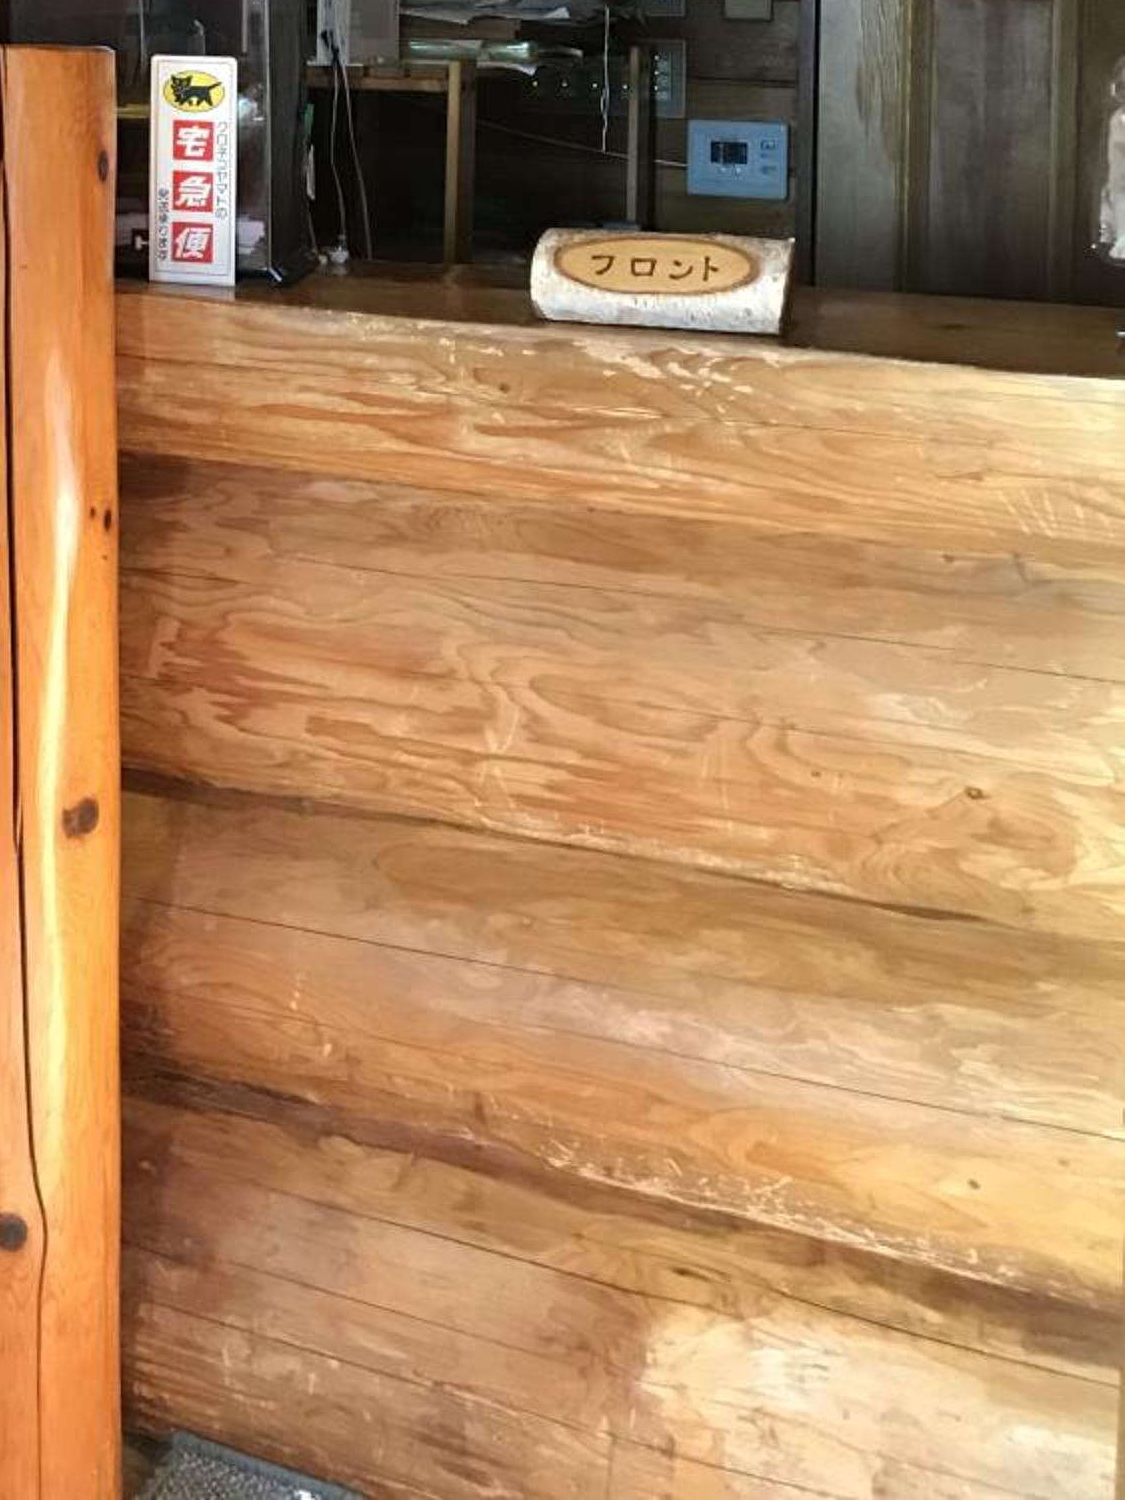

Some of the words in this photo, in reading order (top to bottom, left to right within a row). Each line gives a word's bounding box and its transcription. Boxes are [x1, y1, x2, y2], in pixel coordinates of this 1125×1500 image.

[174, 125, 212, 260] 宅急便
[216, 121, 229, 220] クロネコヤマトの
[591, 253, 720, 282] フロント
